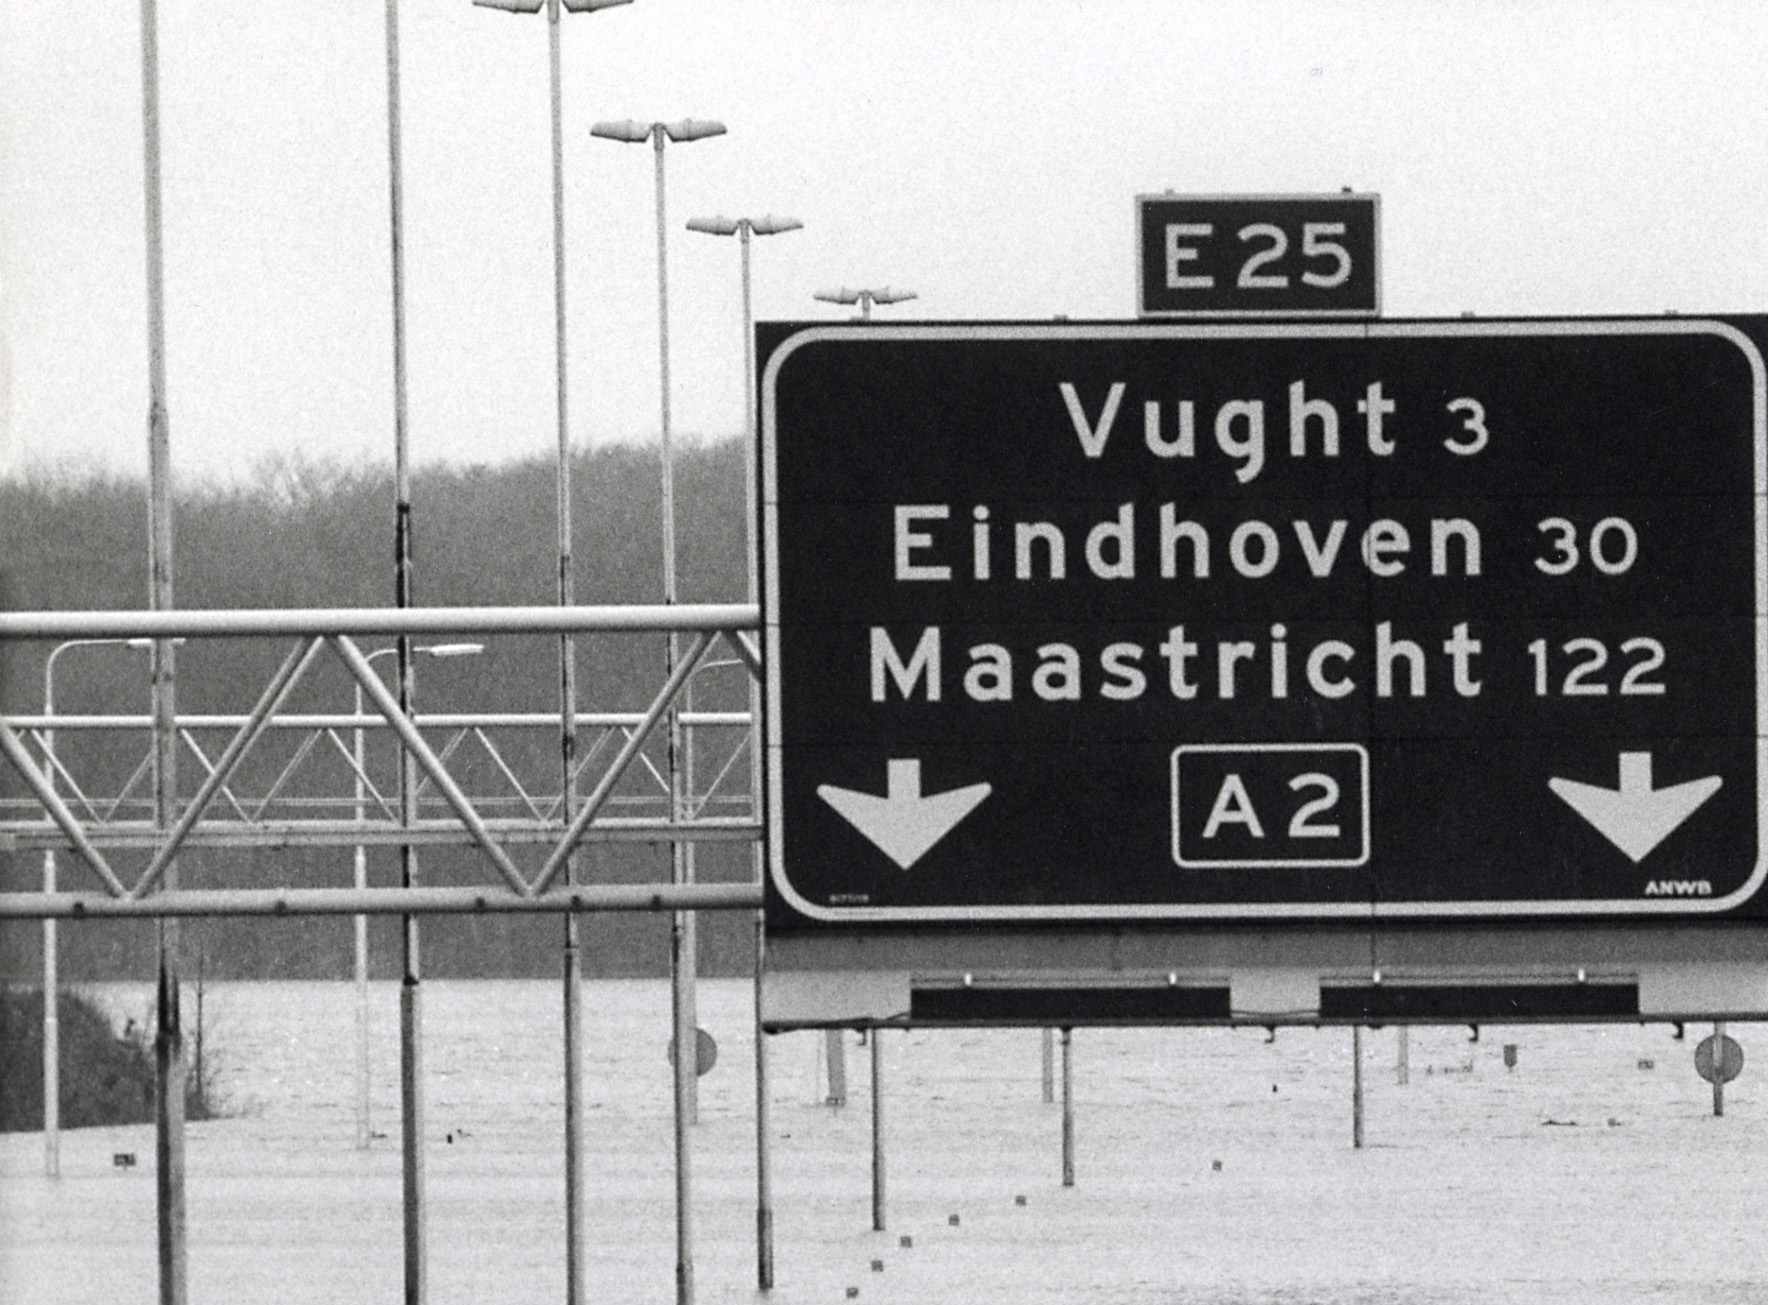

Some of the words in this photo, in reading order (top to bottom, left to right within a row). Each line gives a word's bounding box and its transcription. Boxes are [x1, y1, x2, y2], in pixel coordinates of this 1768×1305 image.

[1164, 222, 1216, 290] E
[1236, 221, 1353, 289] 25
[1058, 378, 1397, 485] Vught
[1443, 396, 1490, 457] 3
[893, 500, 1482, 582] Eindhoven
[1533, 515, 1640, 577] 30
[869, 619, 1483, 703] Maastricht
[1526, 636, 1667, 697] 122
[1644, 879, 1713, 896] ANWB
